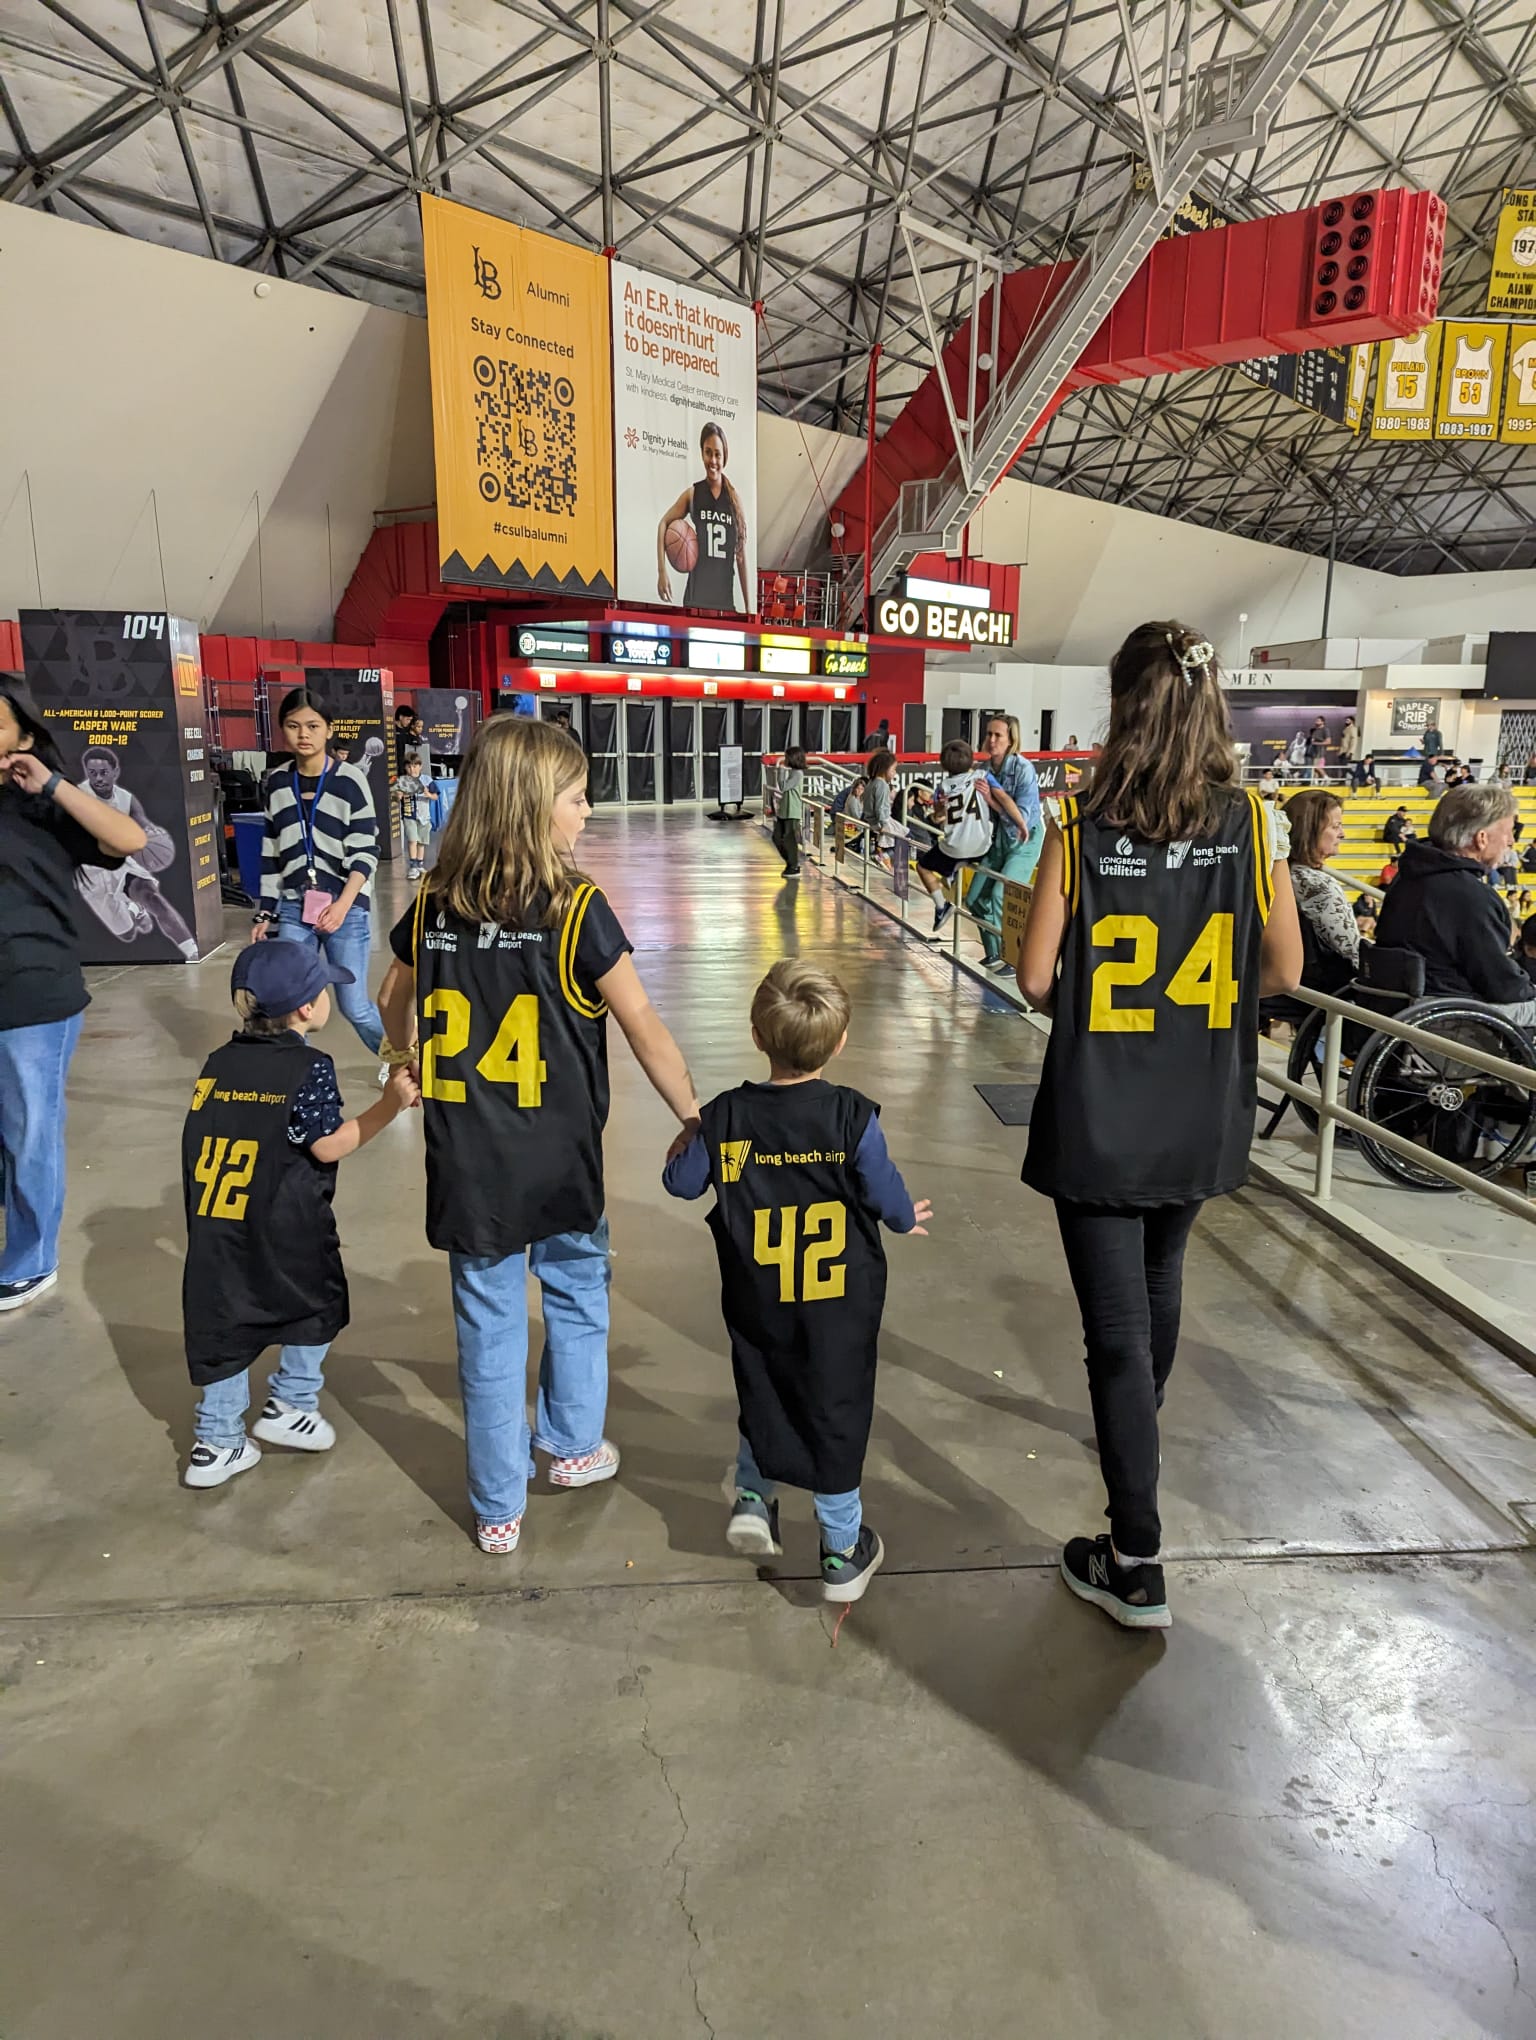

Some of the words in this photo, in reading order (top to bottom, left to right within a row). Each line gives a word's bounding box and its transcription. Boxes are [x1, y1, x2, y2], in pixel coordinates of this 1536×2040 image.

[1514, 239, 1536, 254] 197
[526, 281, 570, 308] Alumni
[1507, 282, 1533, 296] AIAW
[624, 281, 643, 307] An
[646, 288, 673, 326] E.R.
[674, 298, 701, 326] that
[703, 307, 741, 339] knows
[471, 316, 501, 341] Stay
[506, 327, 574, 359] Connected
[625, 305, 634, 328] it
[637, 311, 685, 344] doesn't
[687, 325, 715, 353] hurt
[624, 330, 639, 353] to
[642, 335, 659, 359] be
[663, 345, 720, 377] prepared.
[1391, 361, 1425, 373] POLLARD
[1455, 368, 1490, 380] BROWN
[635, 369, 651, 385] Mary
[652, 374, 676, 389] Medical
[1397, 374, 1418, 399] 15
[1459, 382, 1482, 404] 53
[1375, 417, 1431, 430] 1980-1983
[1439, 422, 1494, 436] 1983-1987
[642, 430, 666, 448] Dignity
[701, 510, 732, 525] BEACH
[493, 522, 567, 544] #csulbalumni
[706, 522, 727, 559] 12
[122, 614, 166, 640] 104
[880, 599, 920, 635] GO
[926, 604, 1011, 645] BEACH!
[825, 653, 838, 675] Go
[839, 655, 867, 673] Beach
[357, 669, 380, 683] 105
[1398, 702, 1435, 714] NAPLES
[1405, 711, 1427, 723] RIB
[73, 720, 108, 731] CASPER
[110, 721, 138, 731] WARE
[88, 734, 128, 745] 2009-12
[947, 790, 982, 825] 24
[1192, 847, 1214, 858] long
[1215, 844, 1239, 854] bach
[1193, 854, 1222, 868] airport
[1099, 864, 1147, 877] Utilities
[498, 940, 521, 950] airport
[1088, 912, 1239, 1032] 24
[421, 987, 547, 1108] 24
[214, 1089, 231, 1103] long
[232, 1089, 258, 1102] beach
[260, 1091, 287, 1106] airport
[755, 1152, 783, 1167] long
[784, 1149, 822, 1164] beach
[825, 1150, 846, 1165] airp
[194, 1136, 259, 1221] 42
[753, 1200, 847, 1303] 42
